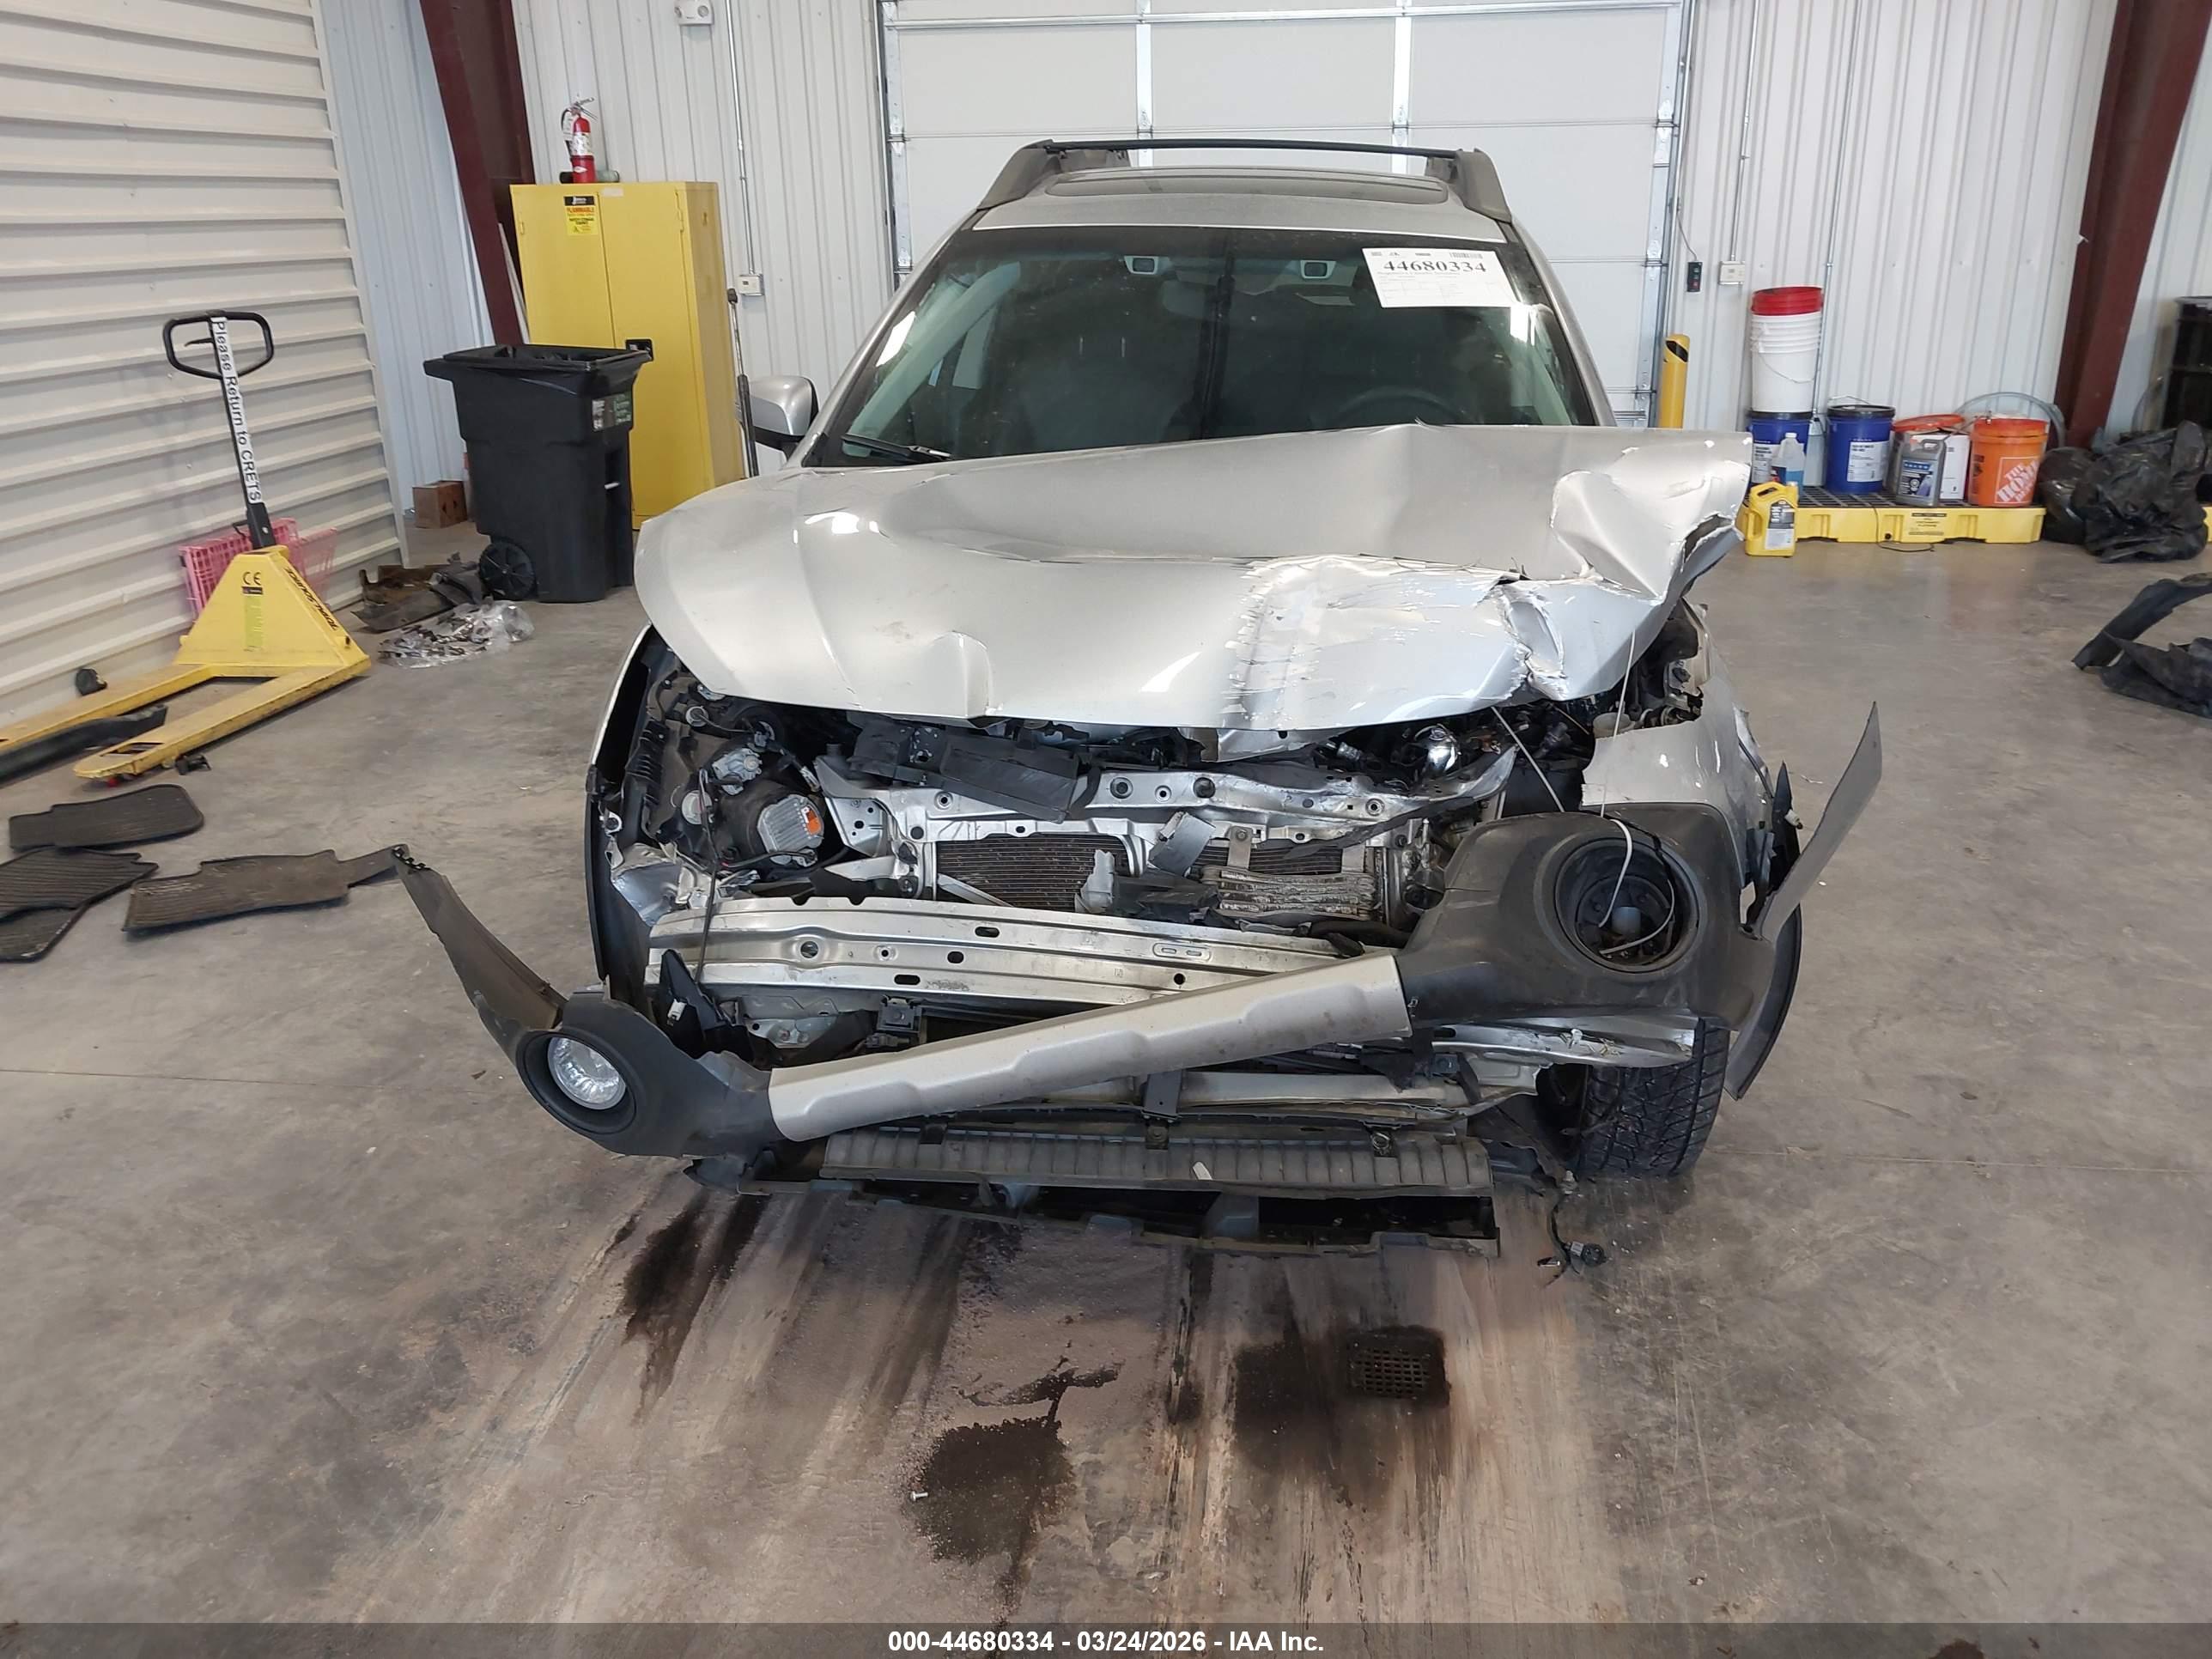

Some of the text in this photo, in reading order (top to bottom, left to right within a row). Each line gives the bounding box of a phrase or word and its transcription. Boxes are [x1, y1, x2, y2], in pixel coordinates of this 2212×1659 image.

[1383, 260, 1487, 272] 44680334
[212, 320, 261, 501] Please Return to CRETS
